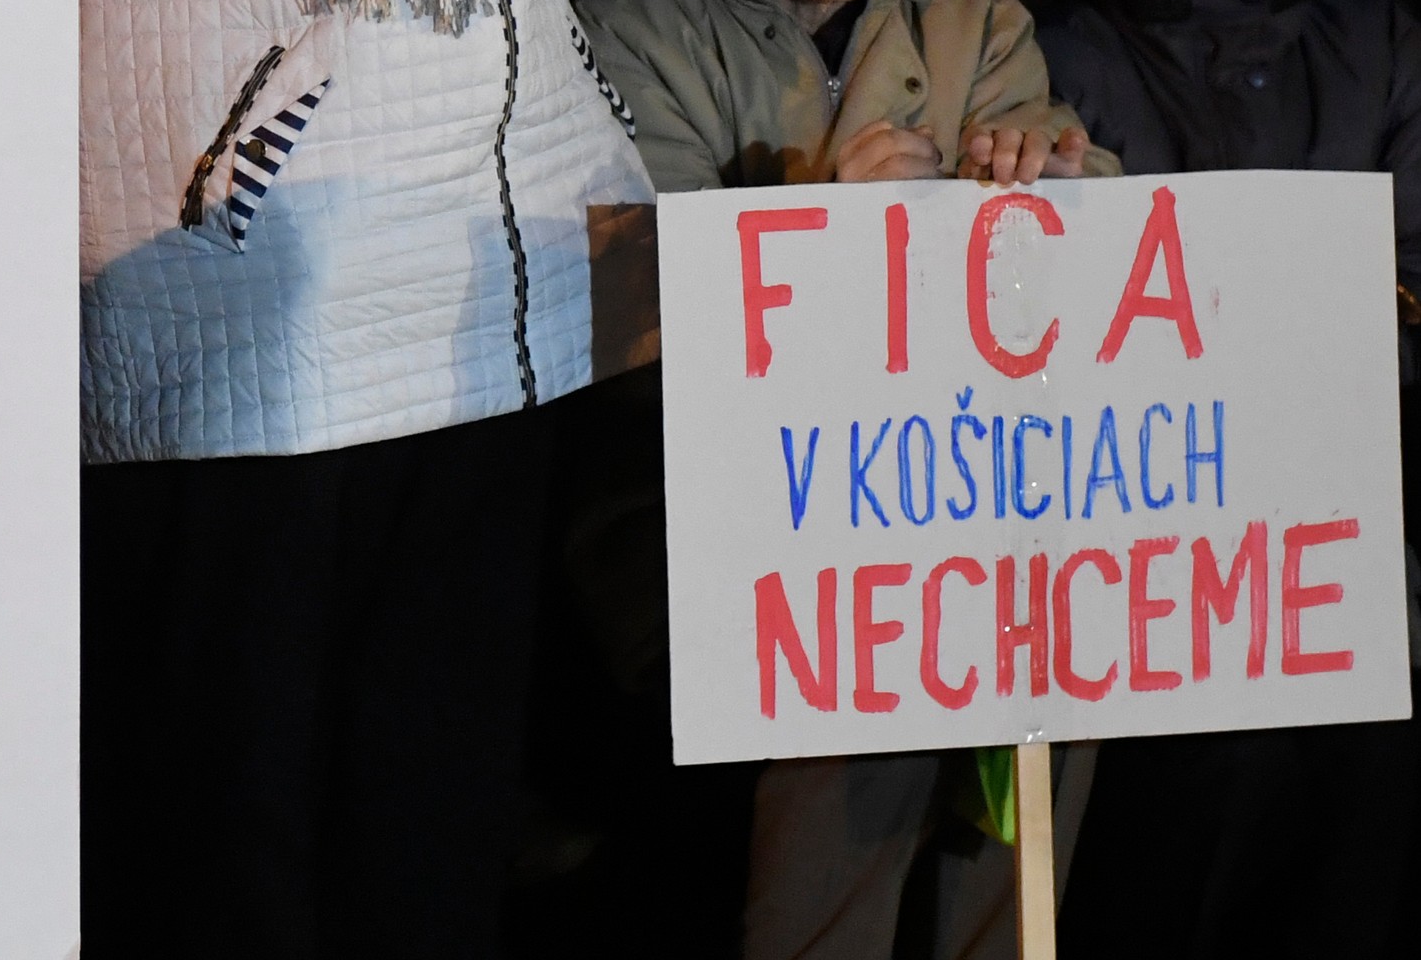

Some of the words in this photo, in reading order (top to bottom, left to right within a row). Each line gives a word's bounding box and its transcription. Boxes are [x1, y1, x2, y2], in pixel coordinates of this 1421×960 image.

[736, 185, 1204, 379] FICA
[780, 426, 820, 531] V
[849, 386, 1225, 528] KOŠICIACH
[754, 518, 1360, 720] NECHCEME
